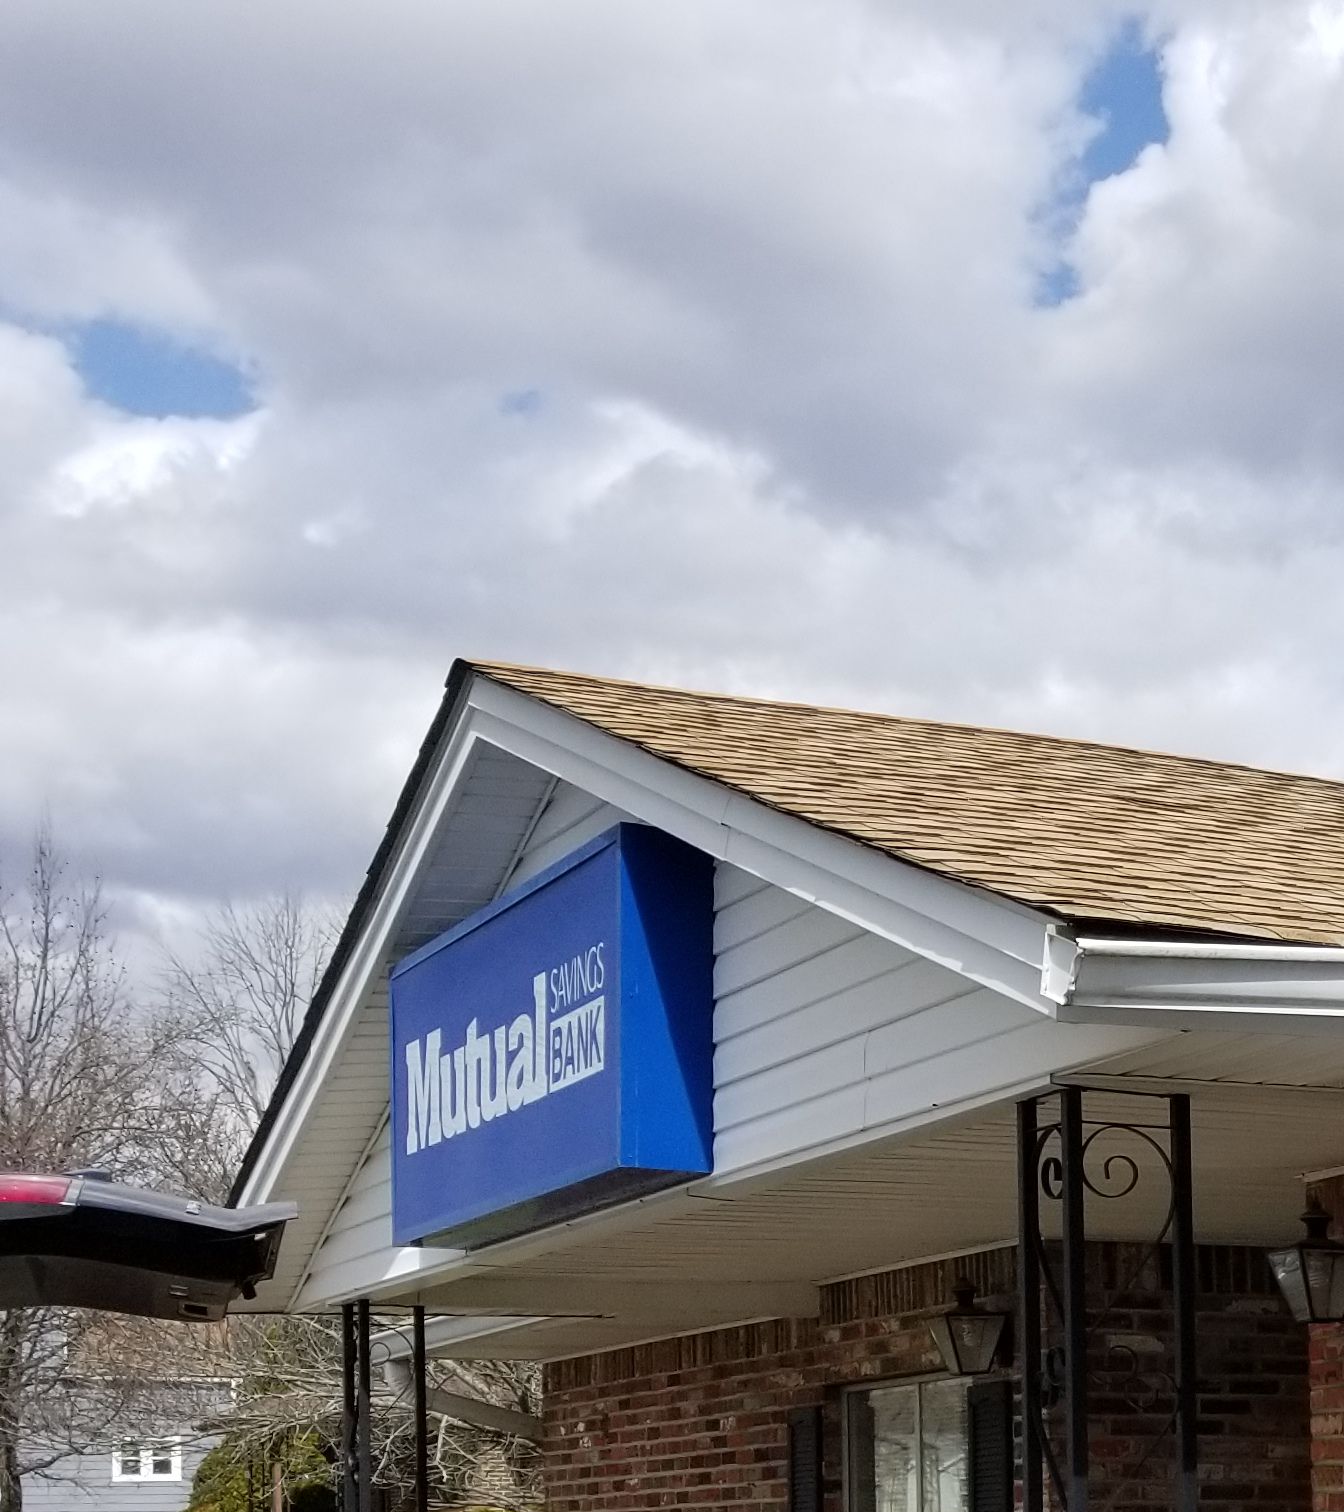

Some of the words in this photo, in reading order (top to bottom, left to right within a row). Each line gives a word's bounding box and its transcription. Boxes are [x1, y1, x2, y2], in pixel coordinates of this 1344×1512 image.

[550, 941, 604, 1013] SAVINGS
[406, 971, 548, 1155] Mutual
[551, 1005, 602, 1087] BANK
